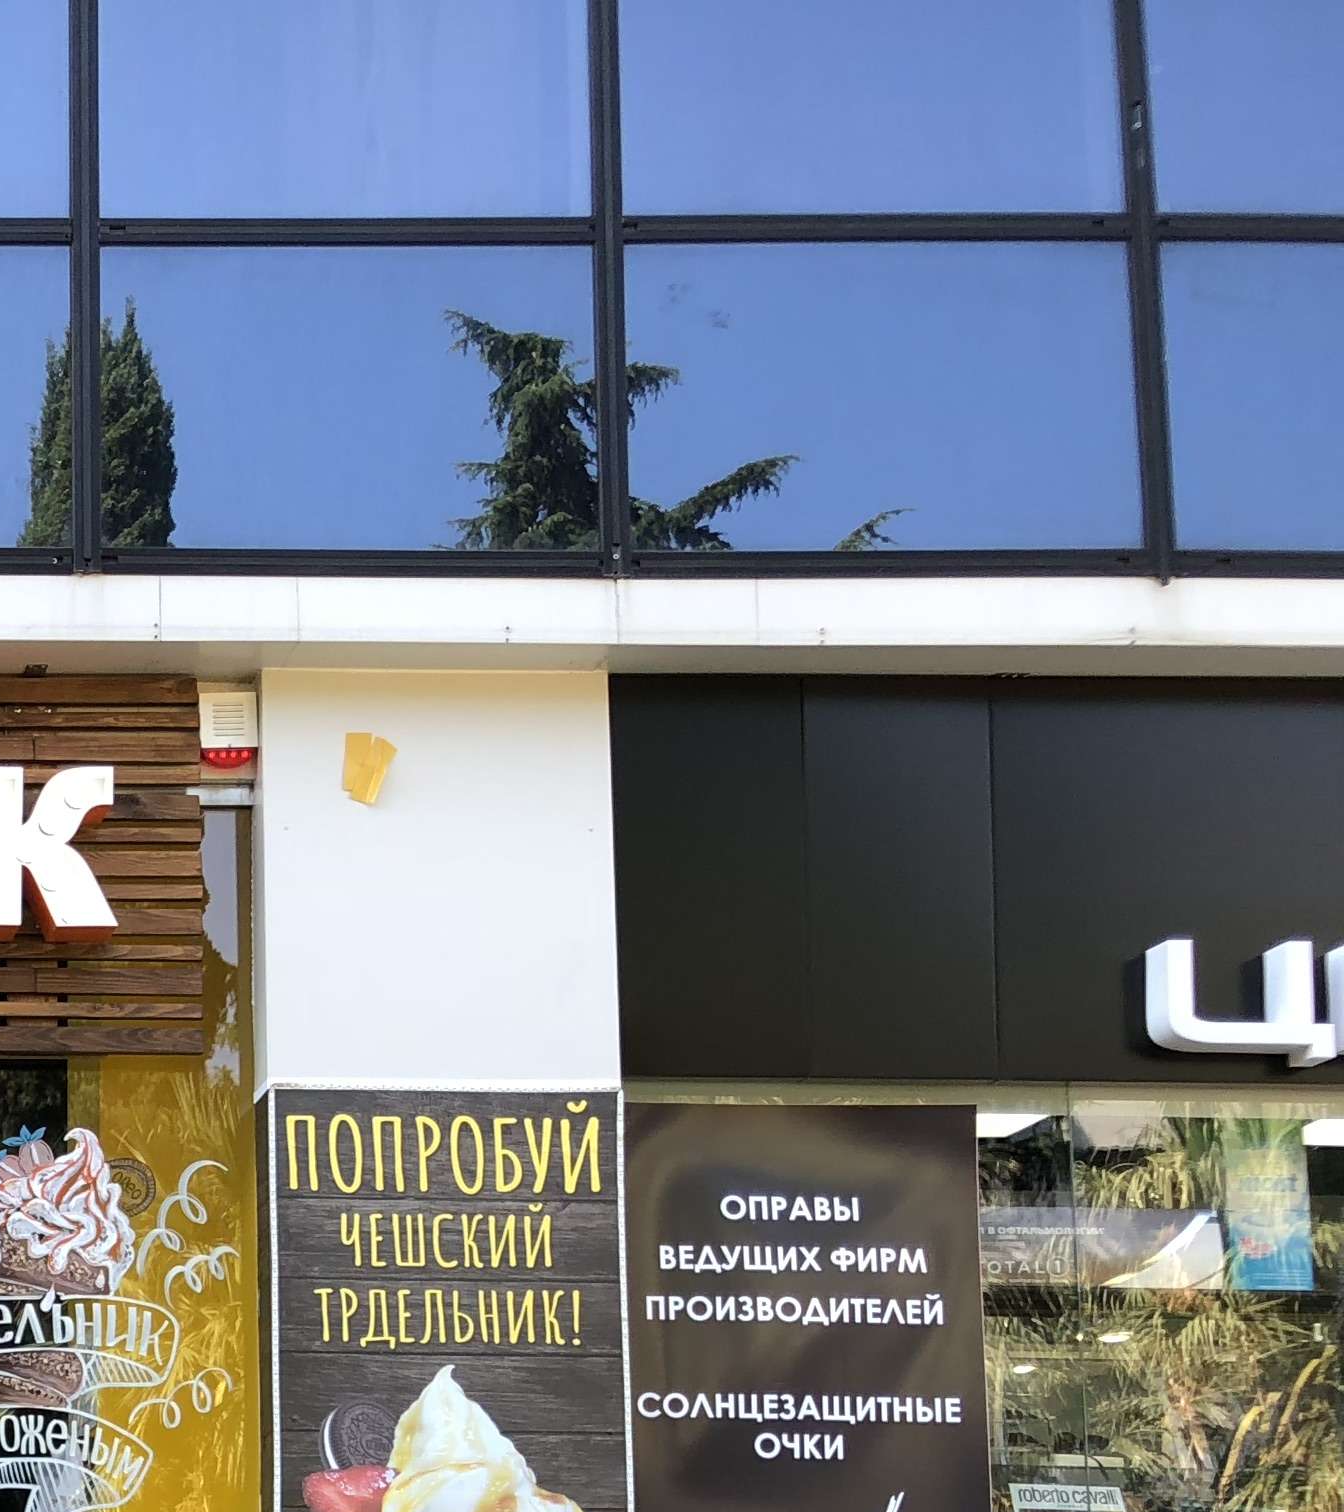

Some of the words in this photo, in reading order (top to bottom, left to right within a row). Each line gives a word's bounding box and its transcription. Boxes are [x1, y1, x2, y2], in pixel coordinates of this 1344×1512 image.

[1144, 938, 1344, 1068] Ц
[284, 1099, 603, 1195] ПОПРОБУЙ
[719, 1194, 860, 1222] ОПРАВЫ
[339, 1202, 554, 1269] ЧЕШСКИЙ
[658, 1244, 822, 1274] ВЕДУЩИХ
[829, 1246, 928, 1274] ФИРМ
[313, 1287, 583, 1350] ТРДЕЛЬНИК!
[645, 1293, 945, 1326] ПРОИЗВОДИТЕЛЕЙ
[636, 1392, 962, 1425] СОЛНЦЕЗАЩИТНЫЕ
[753, 1432, 846, 1460] ОЧКИ
[1018, 1487, 1070, 1504] roberto
